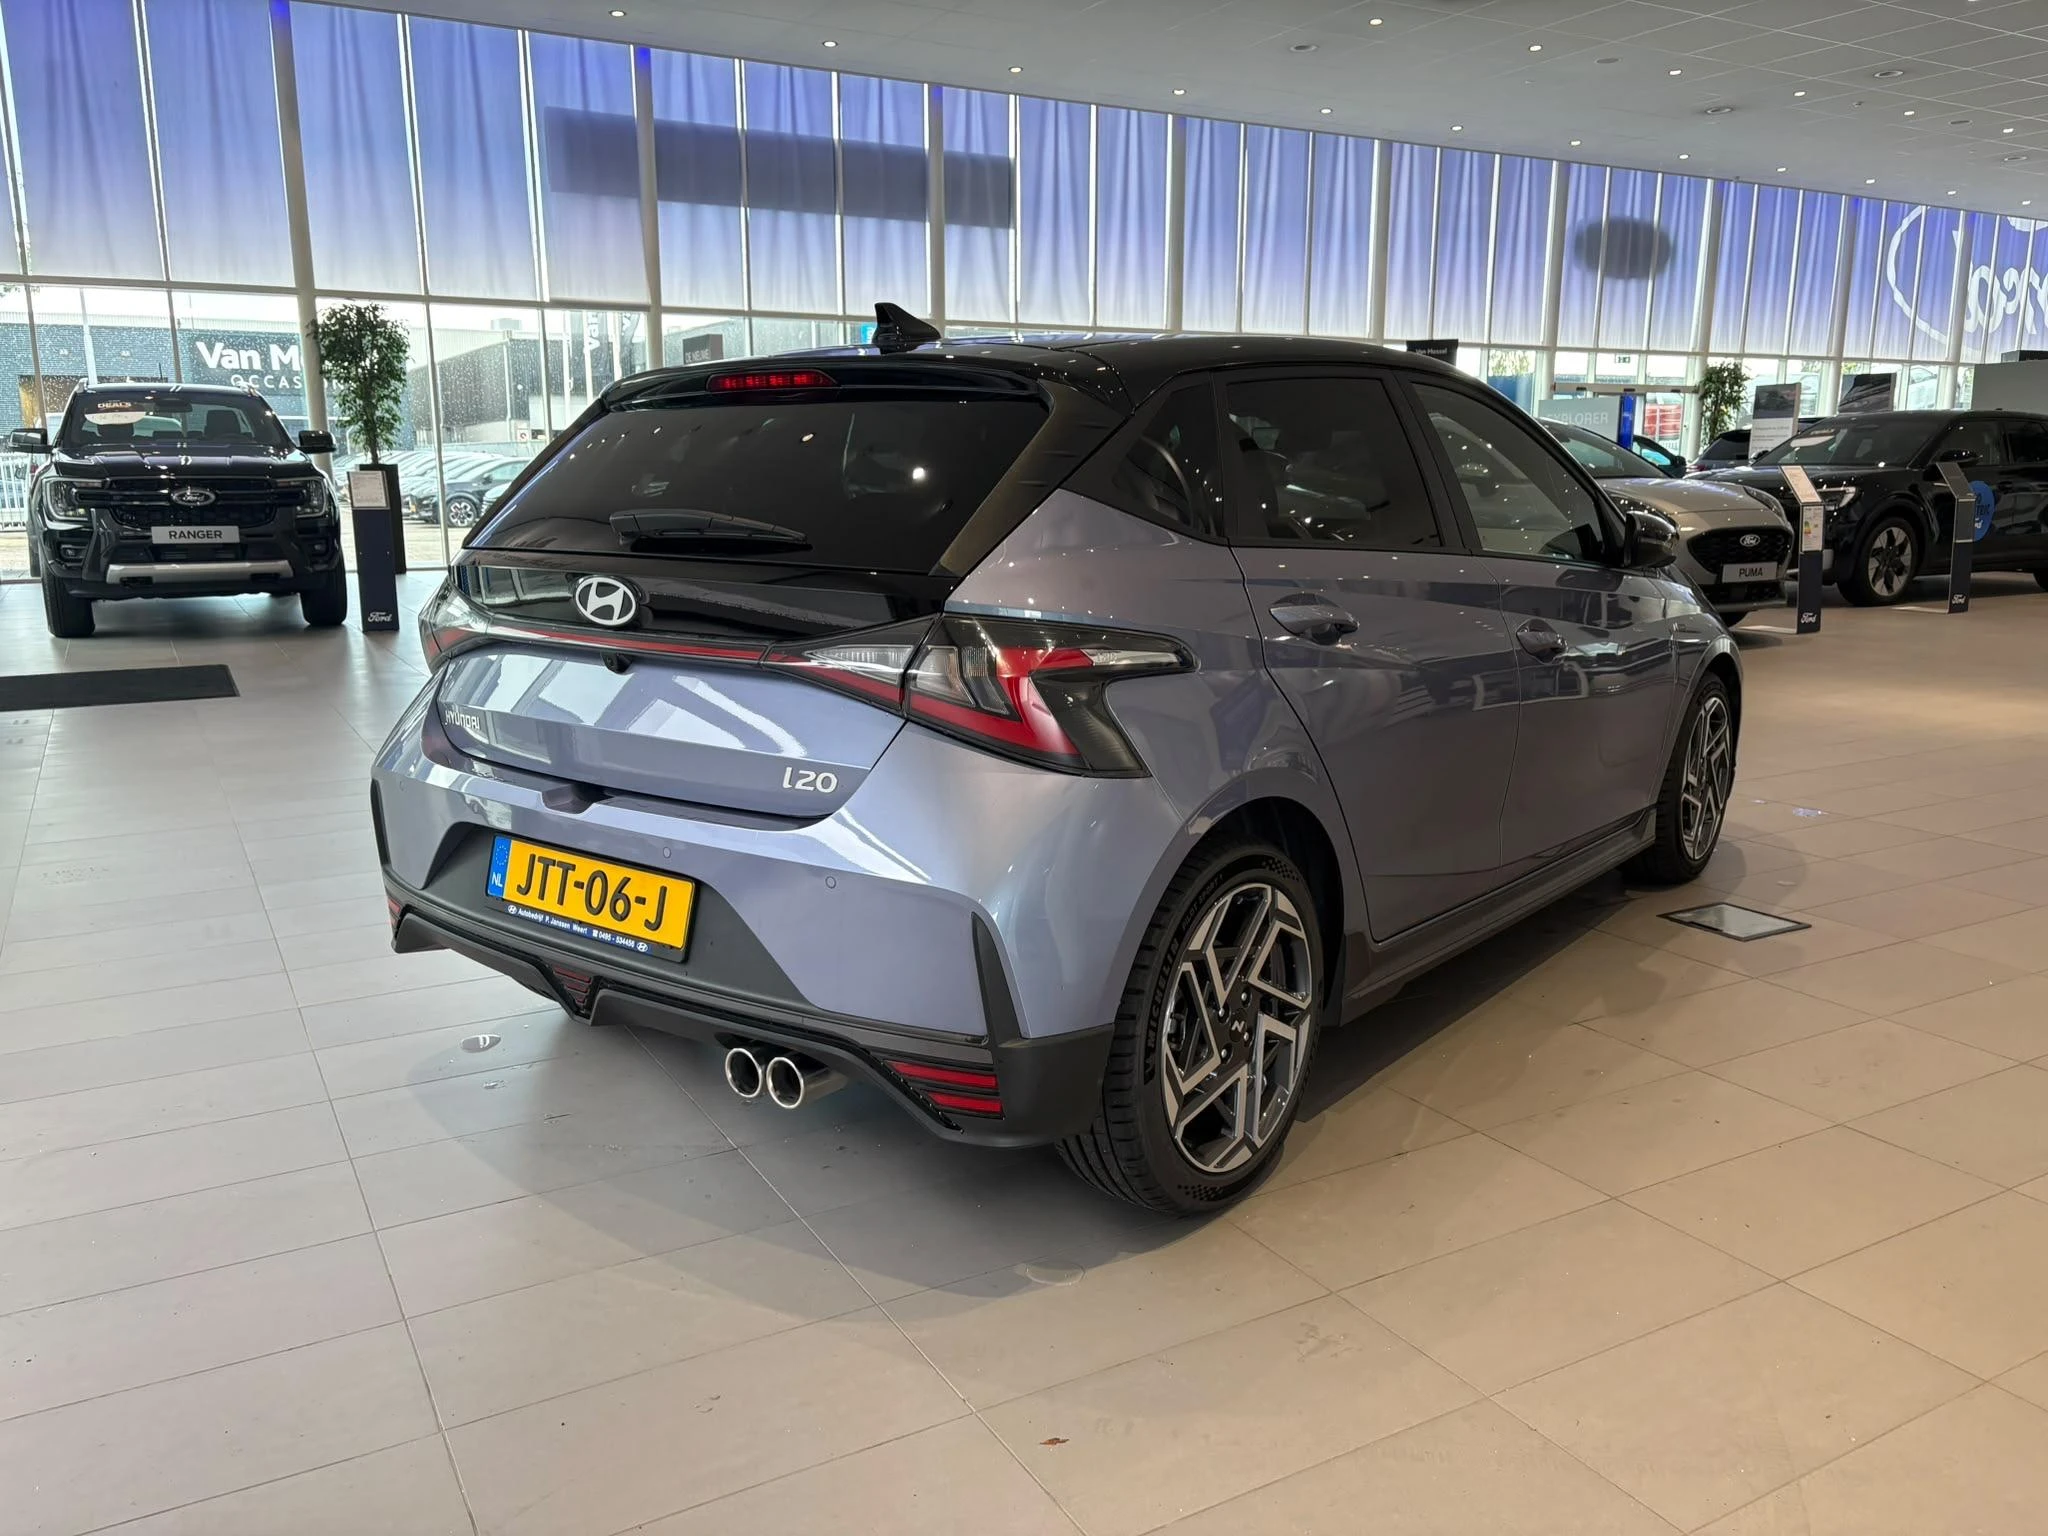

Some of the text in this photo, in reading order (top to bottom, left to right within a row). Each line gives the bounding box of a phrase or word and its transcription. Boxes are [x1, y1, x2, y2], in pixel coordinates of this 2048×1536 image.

[195, 341, 262, 371] Van
[168, 530, 223, 540] RANGER
[1739, 567, 1763, 577] PUMA
[367, 611, 392, 622] Ford
[1800, 612, 1817, 624] Ford
[445, 710, 480, 730] HYUNDAI
[492, 873, 503, 887] NL
[516, 853, 668, 932] JTT-06-J
[518, 908, 544, 923] Autobedrijf
[550, 917, 571, 930] Janssen
[572, 923, 588, 934] Weert
[1147, 937, 1180, 1048] MICHELIN
